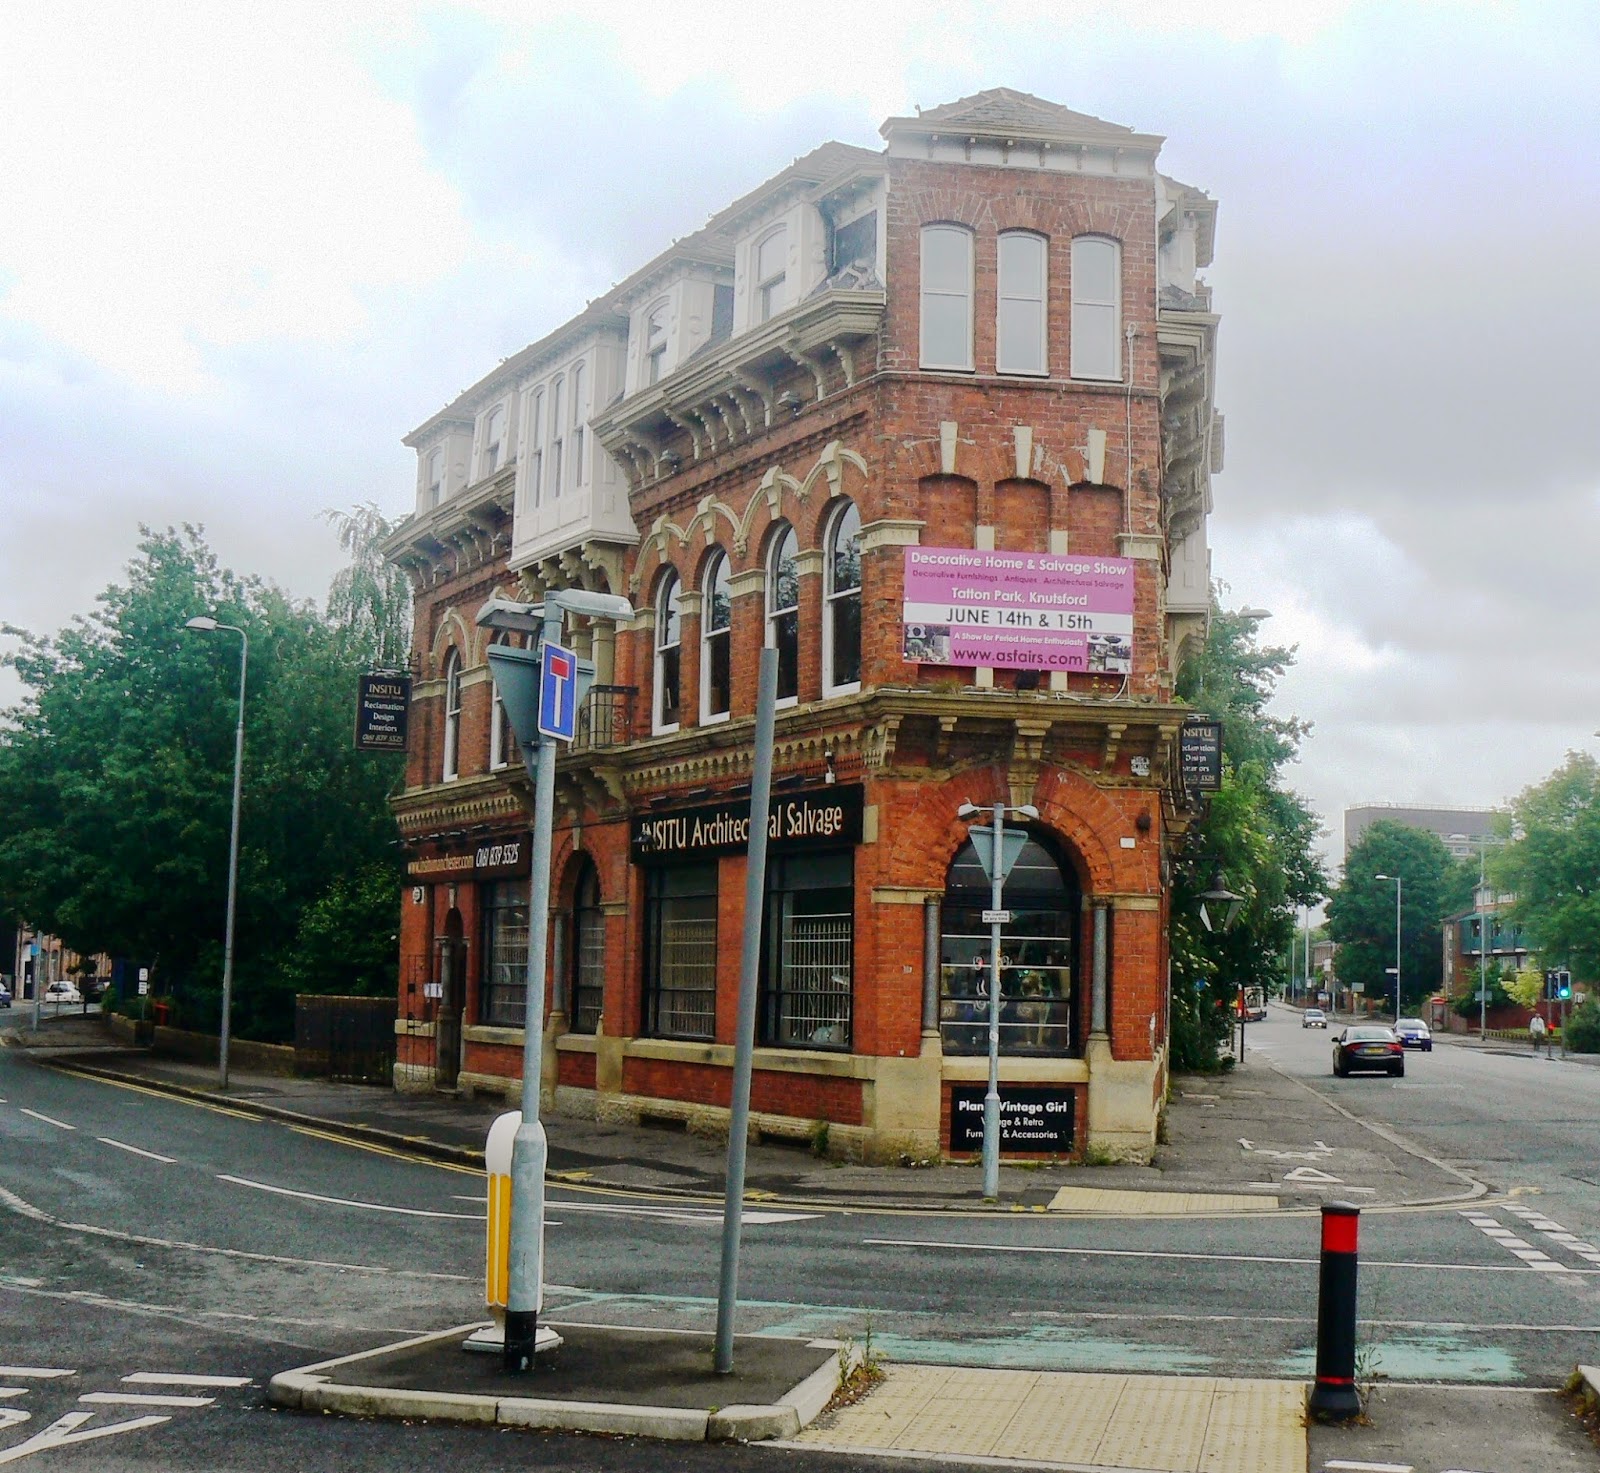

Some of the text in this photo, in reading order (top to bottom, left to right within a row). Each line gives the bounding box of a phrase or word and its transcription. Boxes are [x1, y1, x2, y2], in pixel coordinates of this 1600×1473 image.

[911, 552, 1127, 575] Decorative Home & Salvage Show
[912, 569, 1125, 590] Decorative Furnishings Antiques Architectural Salvage
[951, 587, 1088, 606] Tatton Park, Knutsford
[946, 608, 1093, 630] JUNE 14th & 15th
[954, 632, 1083, 647] A Show for Period Home Enthusiasts
[953, 649, 1083, 666] www.asfairs.com
[369, 684, 401, 694] INSITU
[364, 700, 405, 711] Reclamation
[373, 712, 395, 722] Design
[369, 723, 397, 732] Interiors
[787, 801, 843, 836] Salvage
[502, 843, 520, 864] 5525
[999, 1101, 1043, 1115] Vintage
[1045, 1101, 1067, 1112] Girl
[1014, 1117, 1021, 1126] &
[1023, 1117, 1044, 1126] Retro
[1002, 1129, 1009, 1138] &
[1011, 1129, 1058, 1139] Accessories
